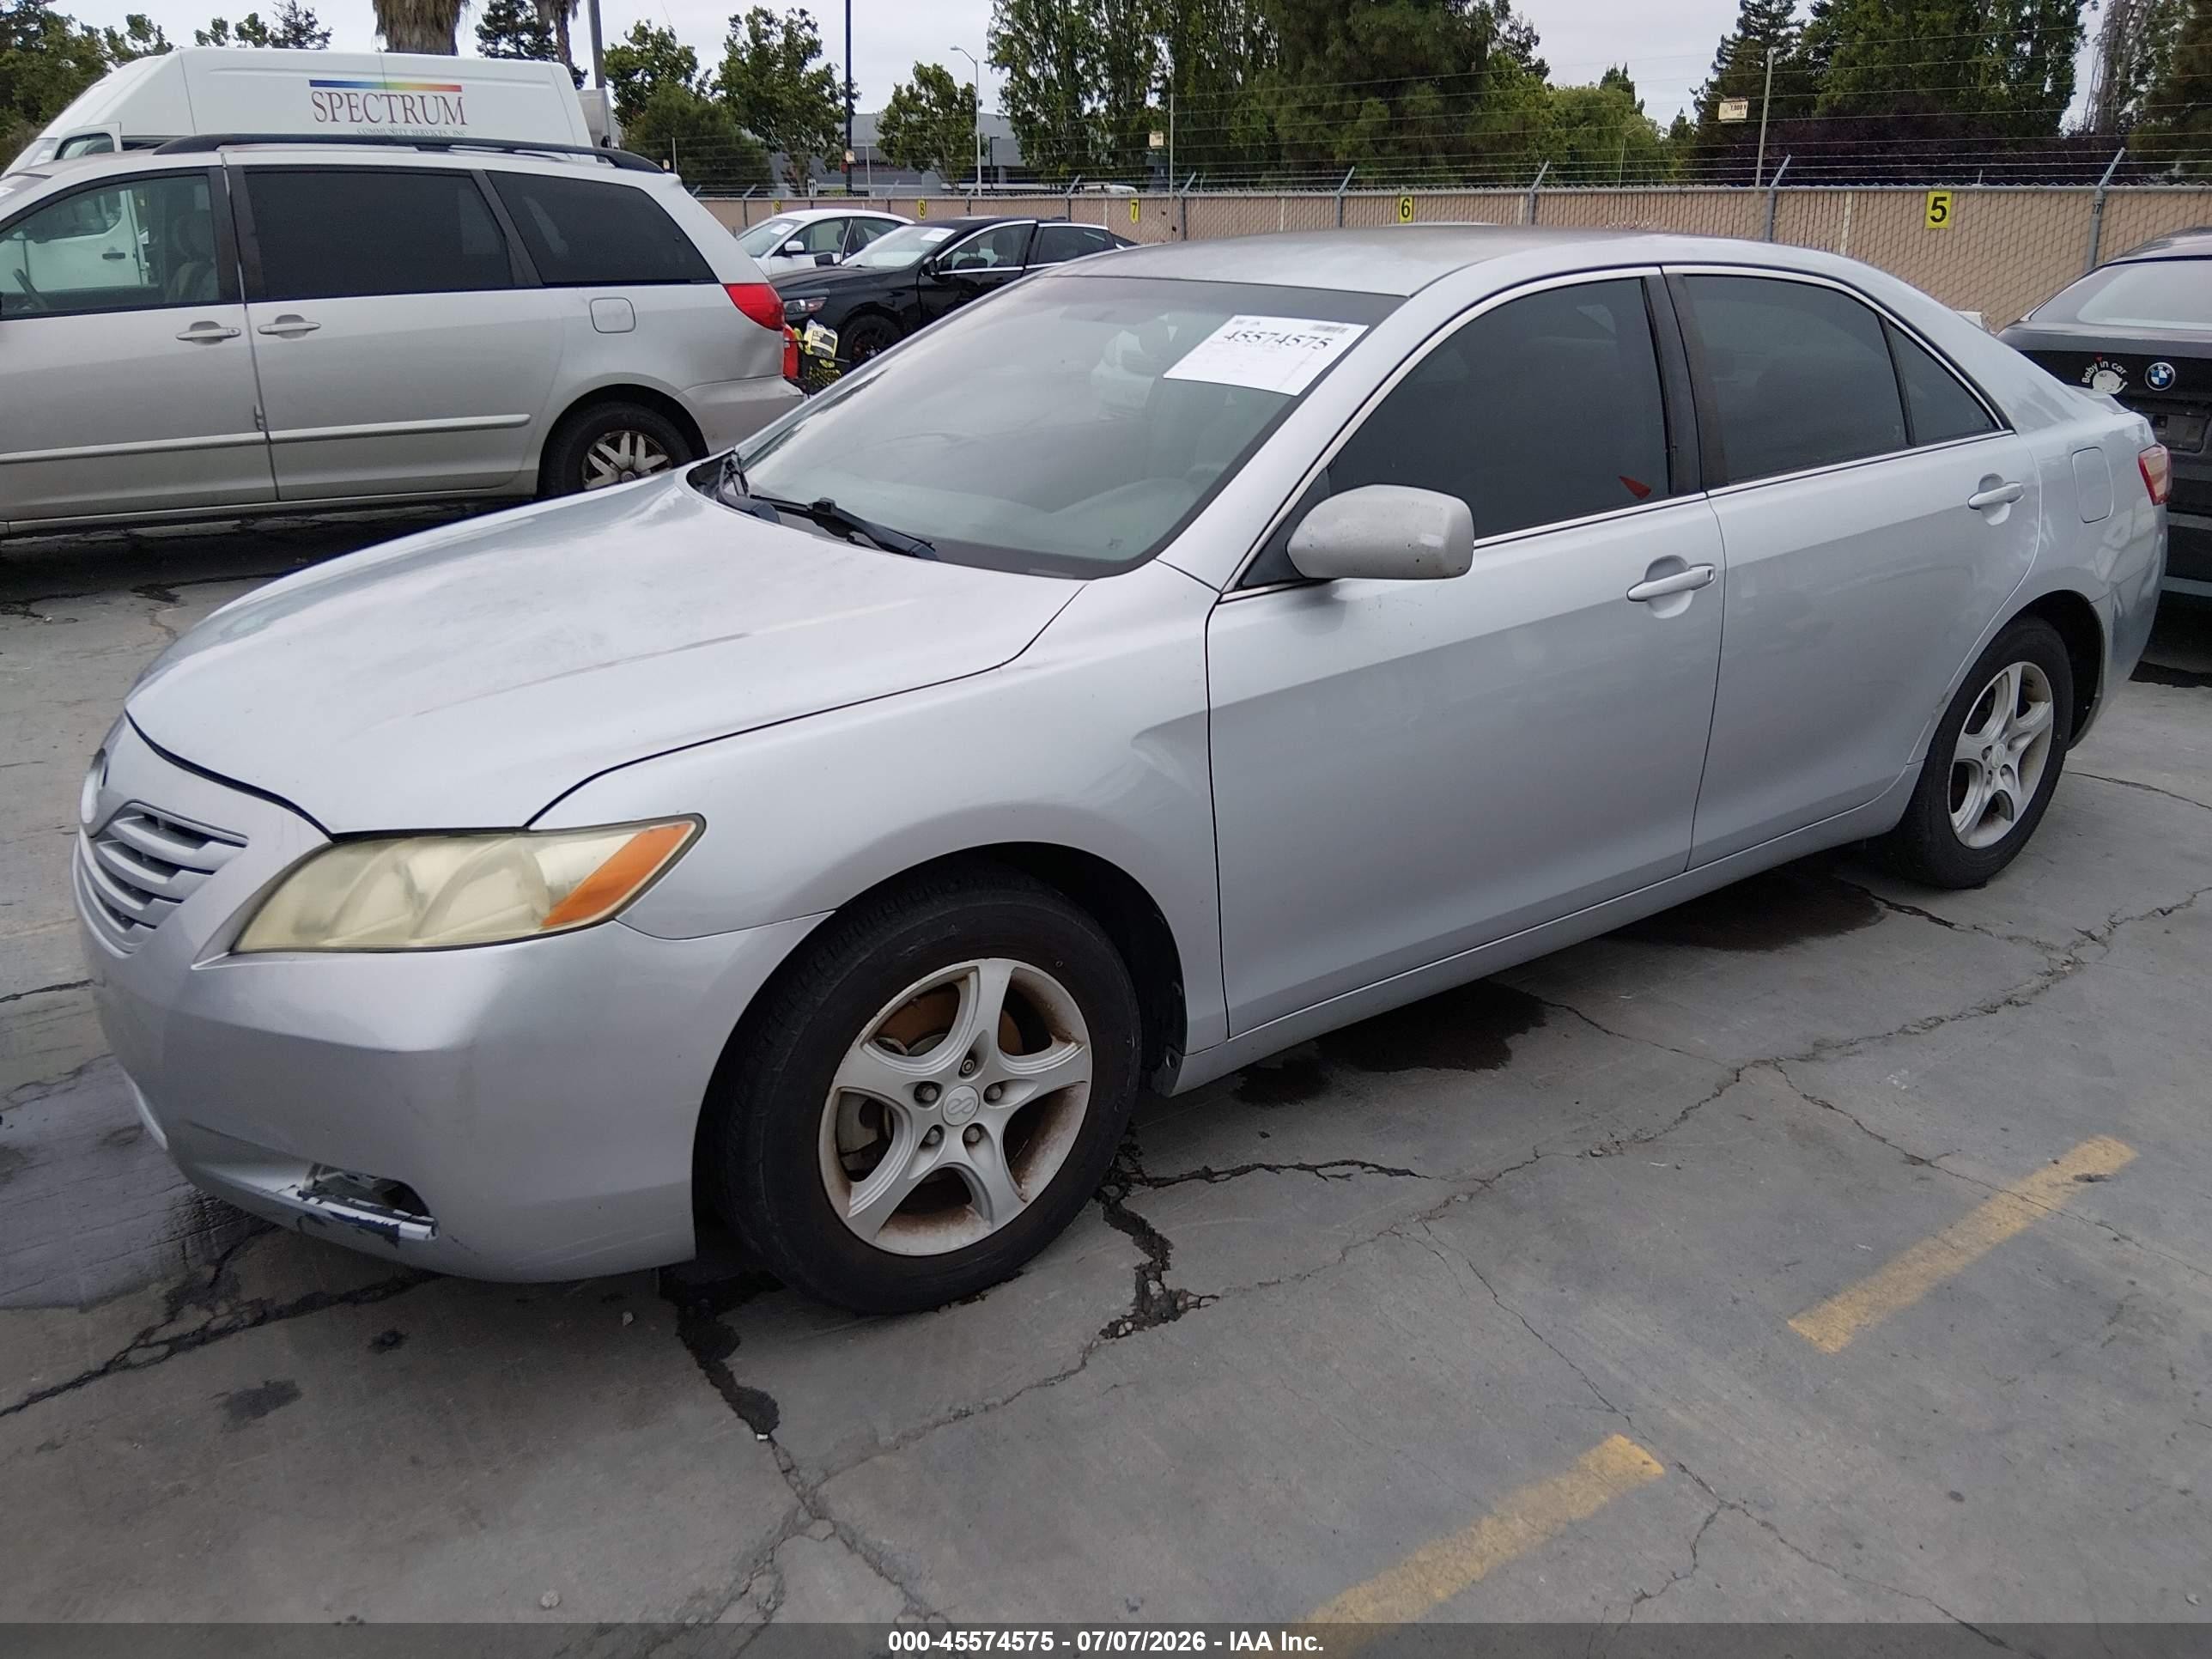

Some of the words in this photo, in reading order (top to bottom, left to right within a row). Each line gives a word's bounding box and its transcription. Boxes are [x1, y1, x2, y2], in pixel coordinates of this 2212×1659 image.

[311, 91, 468, 126] SPECTRUM
[920, 202, 926, 216] 8
[1131, 202, 1138, 219] 7
[1401, 198, 1411, 218] 6
[1929, 197, 1948, 223] 5
[1224, 330, 1333, 349] 45574575
[2081, 363, 2099, 384] Baby
[2100, 361, 2110, 369] in
[2111, 362, 2129, 375] car
